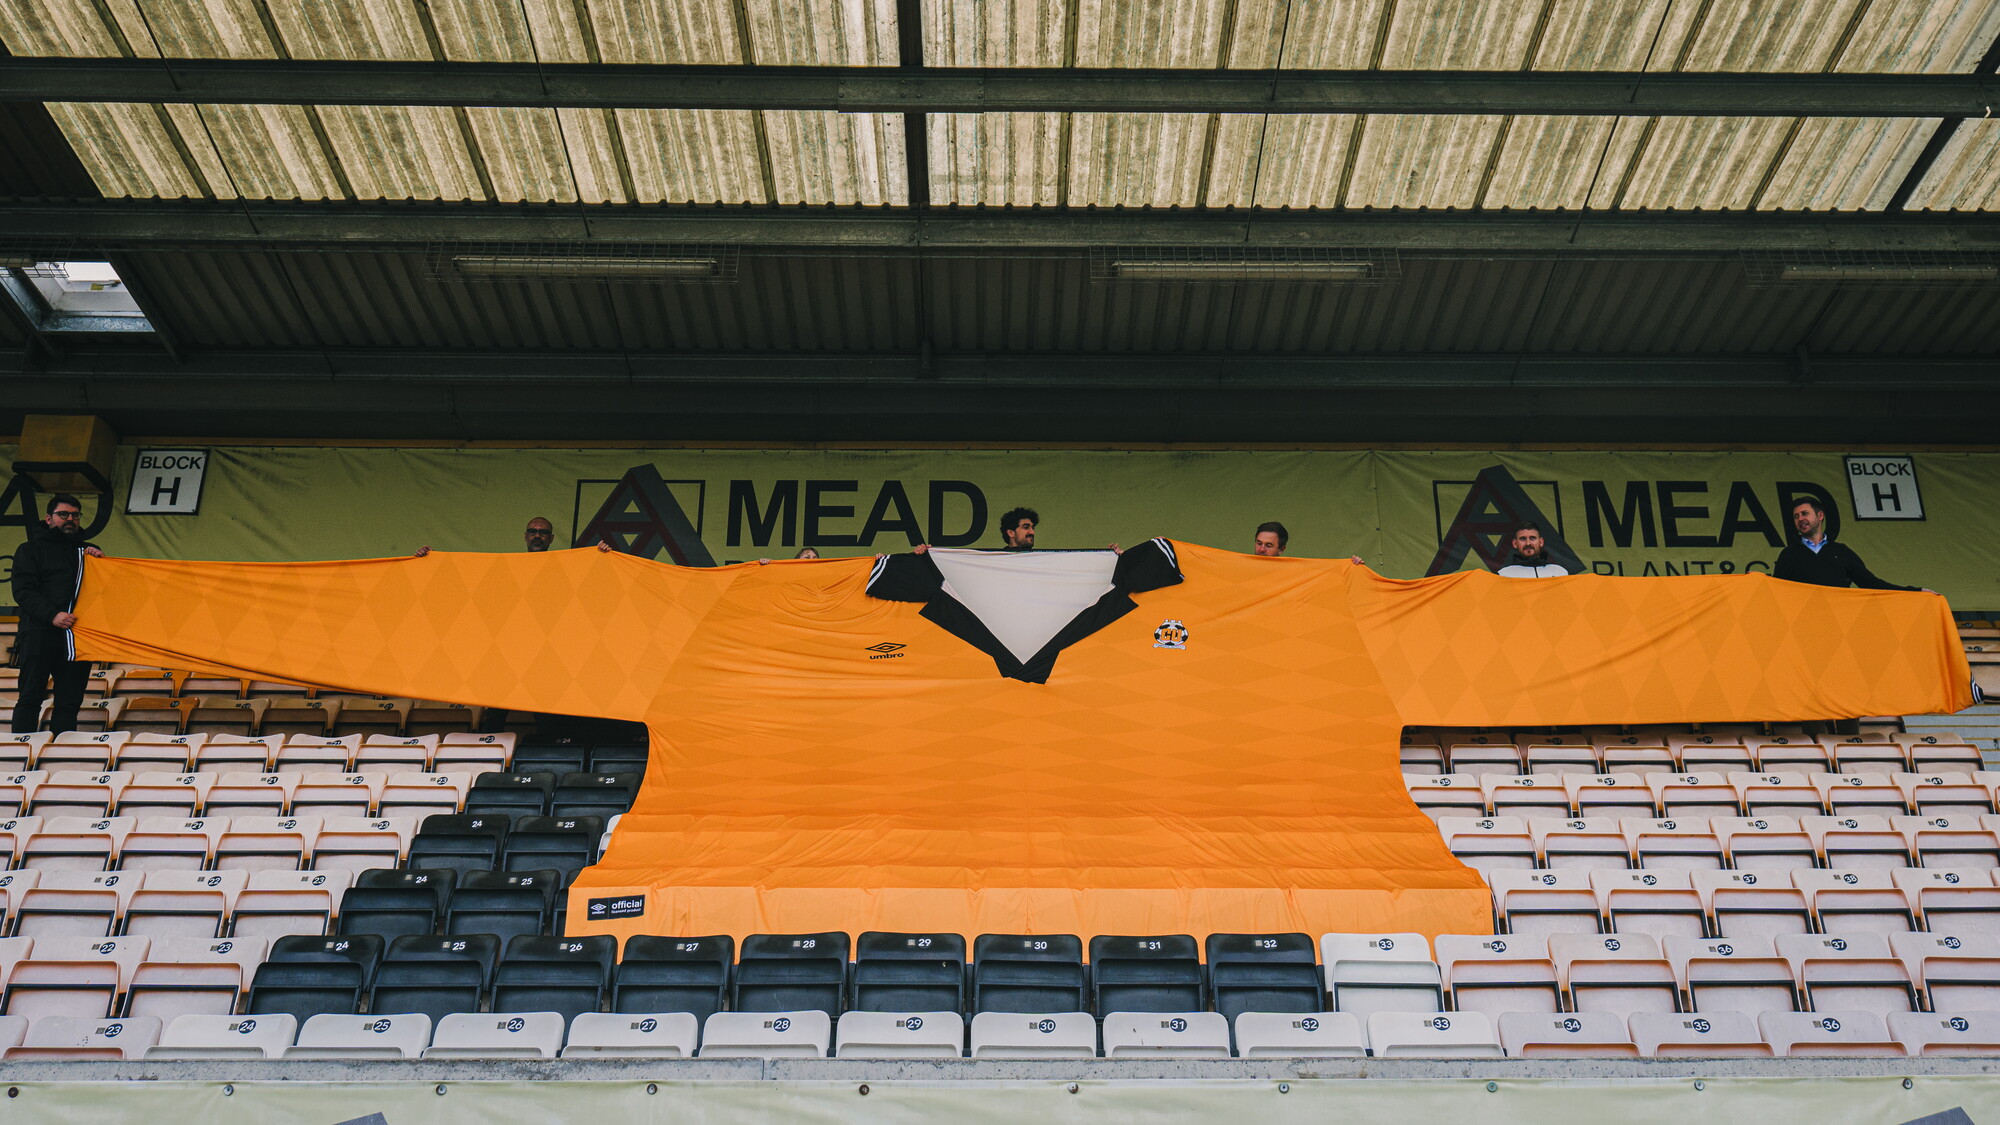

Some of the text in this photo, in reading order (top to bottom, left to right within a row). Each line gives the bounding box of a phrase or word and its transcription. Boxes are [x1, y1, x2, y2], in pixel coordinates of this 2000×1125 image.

[140, 455, 201, 470] BLOCK
[1851, 462, 1911, 476] BLOCK
[151, 477, 181, 506] H
[1872, 483, 1902, 512] H
[725, 479, 989, 547] MEAD
[1581, 480, 1841, 548] MEAD
[869, 652, 905, 660] umbro
[15, 776, 26, 784] 18
[267, 776, 278, 784] 21
[353, 776, 364, 784] 22
[1523, 779, 1534, 787] 36
[1769, 777, 1781, 785] 39
[1931, 777, 1943, 785] 41
[5, 821, 16, 829] 19
[98, 821, 110, 829] 20
[191, 821, 204, 829] 21
[284, 820, 297, 828] 22
[378, 821, 390, 829] 23
[1482, 821, 1494, 829] 35
[1574, 821, 1586, 829] 36
[1664, 821, 1676, 829] 37
[1756, 820, 1768, 829] 38
[1846, 820, 1858, 828] 39
[1936, 819, 1948, 827] 40
[0, 876, 13, 885] 20
[106, 876, 119, 885] 21
[208, 876, 221, 885] 22
[313, 875, 326, 885] 23
[415, 876, 427, 884] 24
[521, 877, 533, 885] 25
[1543, 875, 1556, 884] 35
[1643, 875, 1656, 884] 36
[1743, 874, 1757, 883] 37
[1844, 874, 1858, 883] 38
[1946, 873, 1959, 883] 39
[612, 899, 643, 909] official
[101, 942, 115, 953] 22
[218, 942, 232, 952] 23
[335, 941, 349, 951] 24
[452, 942, 466, 950] 25
[569, 942, 583, 952] 26
[686, 942, 699, 952] 27
[802, 940, 816, 949] 28
[918, 938, 931, 947] 29
[1034, 941, 1047, 950] 30
[1149, 941, 1161, 950] 31
[1263, 939, 1277, 948] 32
[1379, 939, 1394, 949] 33
[1491, 941, 1506, 952] 34
[1605, 940, 1620, 950] 35
[1831, 939, 1847, 950] 37
[1944, 937, 1960, 948] 38
[1717, 944, 1733, 955] 36
[238, 1021, 256, 1032] 24
[373, 1020, 390, 1031] 25
[507, 1019, 524, 1031] 26
[639, 1020, 656, 1031] 27
[773, 1019, 790, 1030] 28
[906, 1018, 923, 1029] 29
[1039, 1020, 1055, 1031] 30
[1170, 1019, 1185, 1030] 31
[1302, 1019, 1319, 1030] 32
[1433, 1018, 1450, 1029] 33
[1564, 1020, 1581, 1031] 34
[1693, 1020, 1711, 1032] 35
[1822, 1019, 1840, 1031] 36
[1950, 1018, 1968, 1030] 37
[105, 1024, 122, 1036] 23
